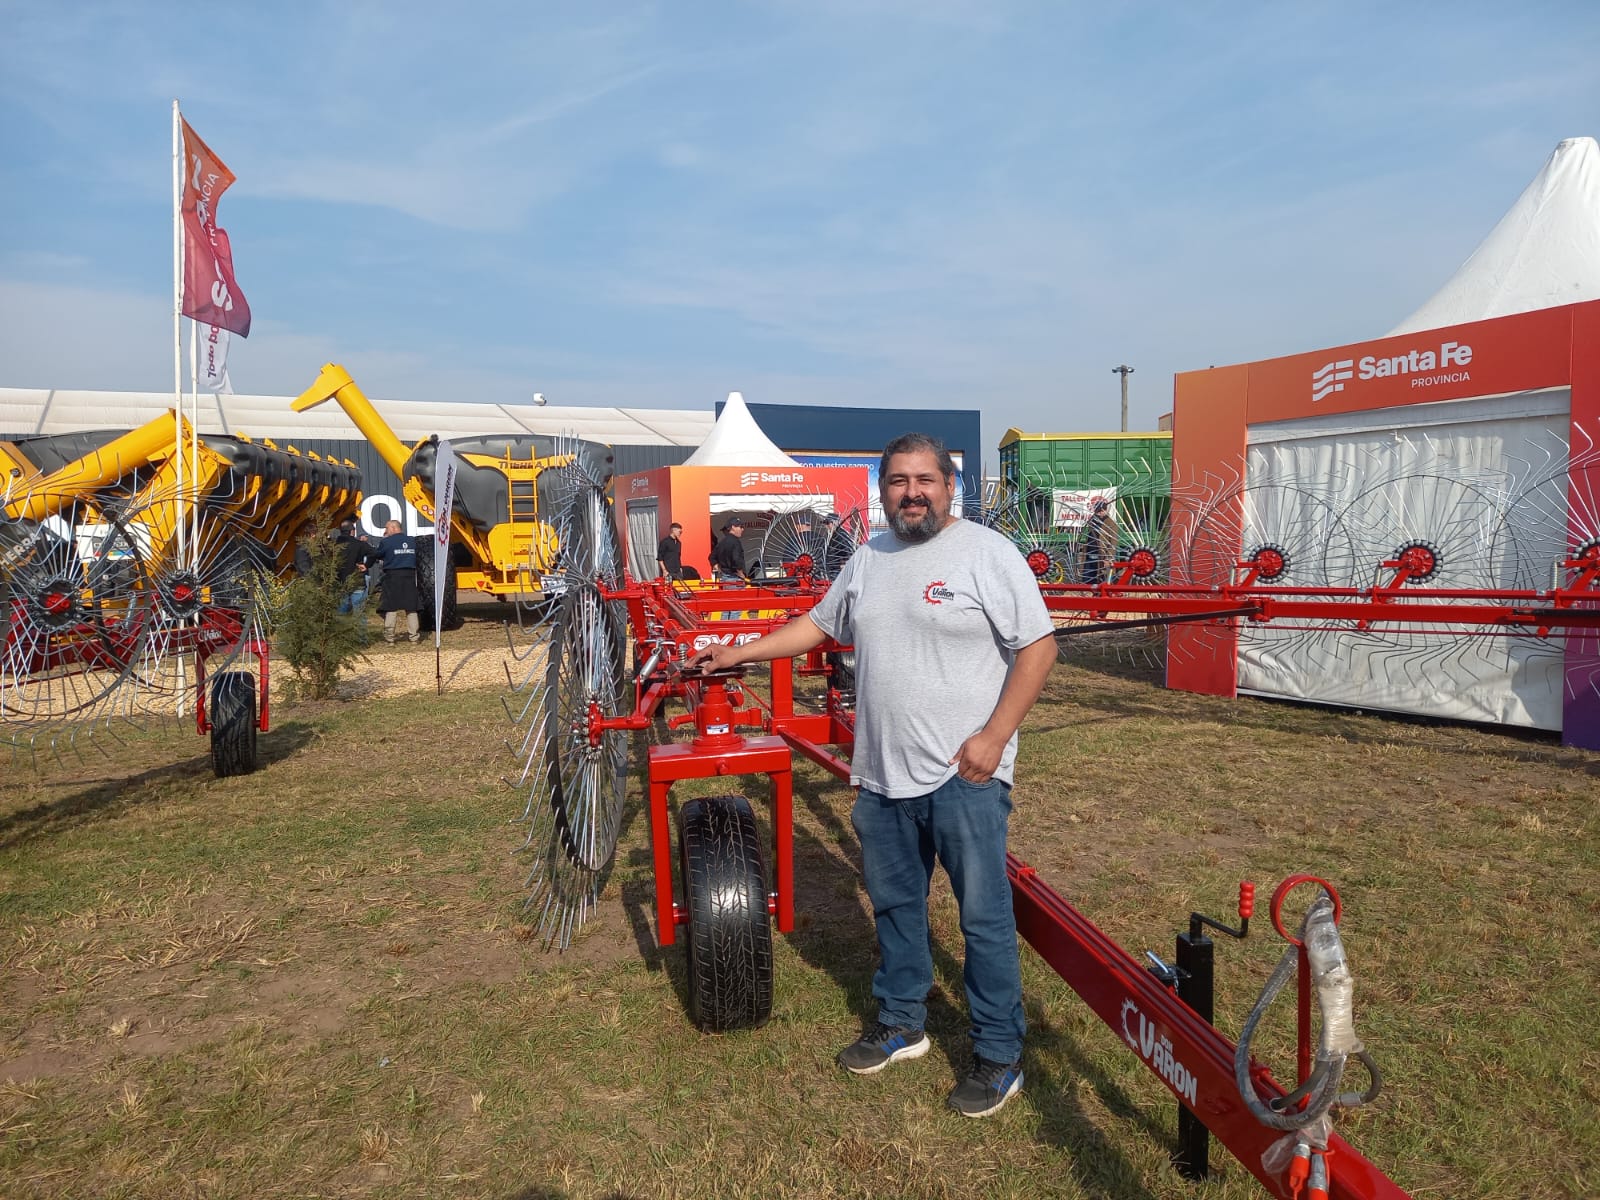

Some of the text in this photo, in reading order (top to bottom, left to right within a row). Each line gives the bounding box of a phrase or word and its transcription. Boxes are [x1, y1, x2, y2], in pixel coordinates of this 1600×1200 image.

[1358, 341, 1473, 380] Santa Fe
[1411, 371, 1471, 389] PROVINCIA
[761, 472, 804, 482] Santa Fe
[1140, 1012, 1198, 1108] VARON
